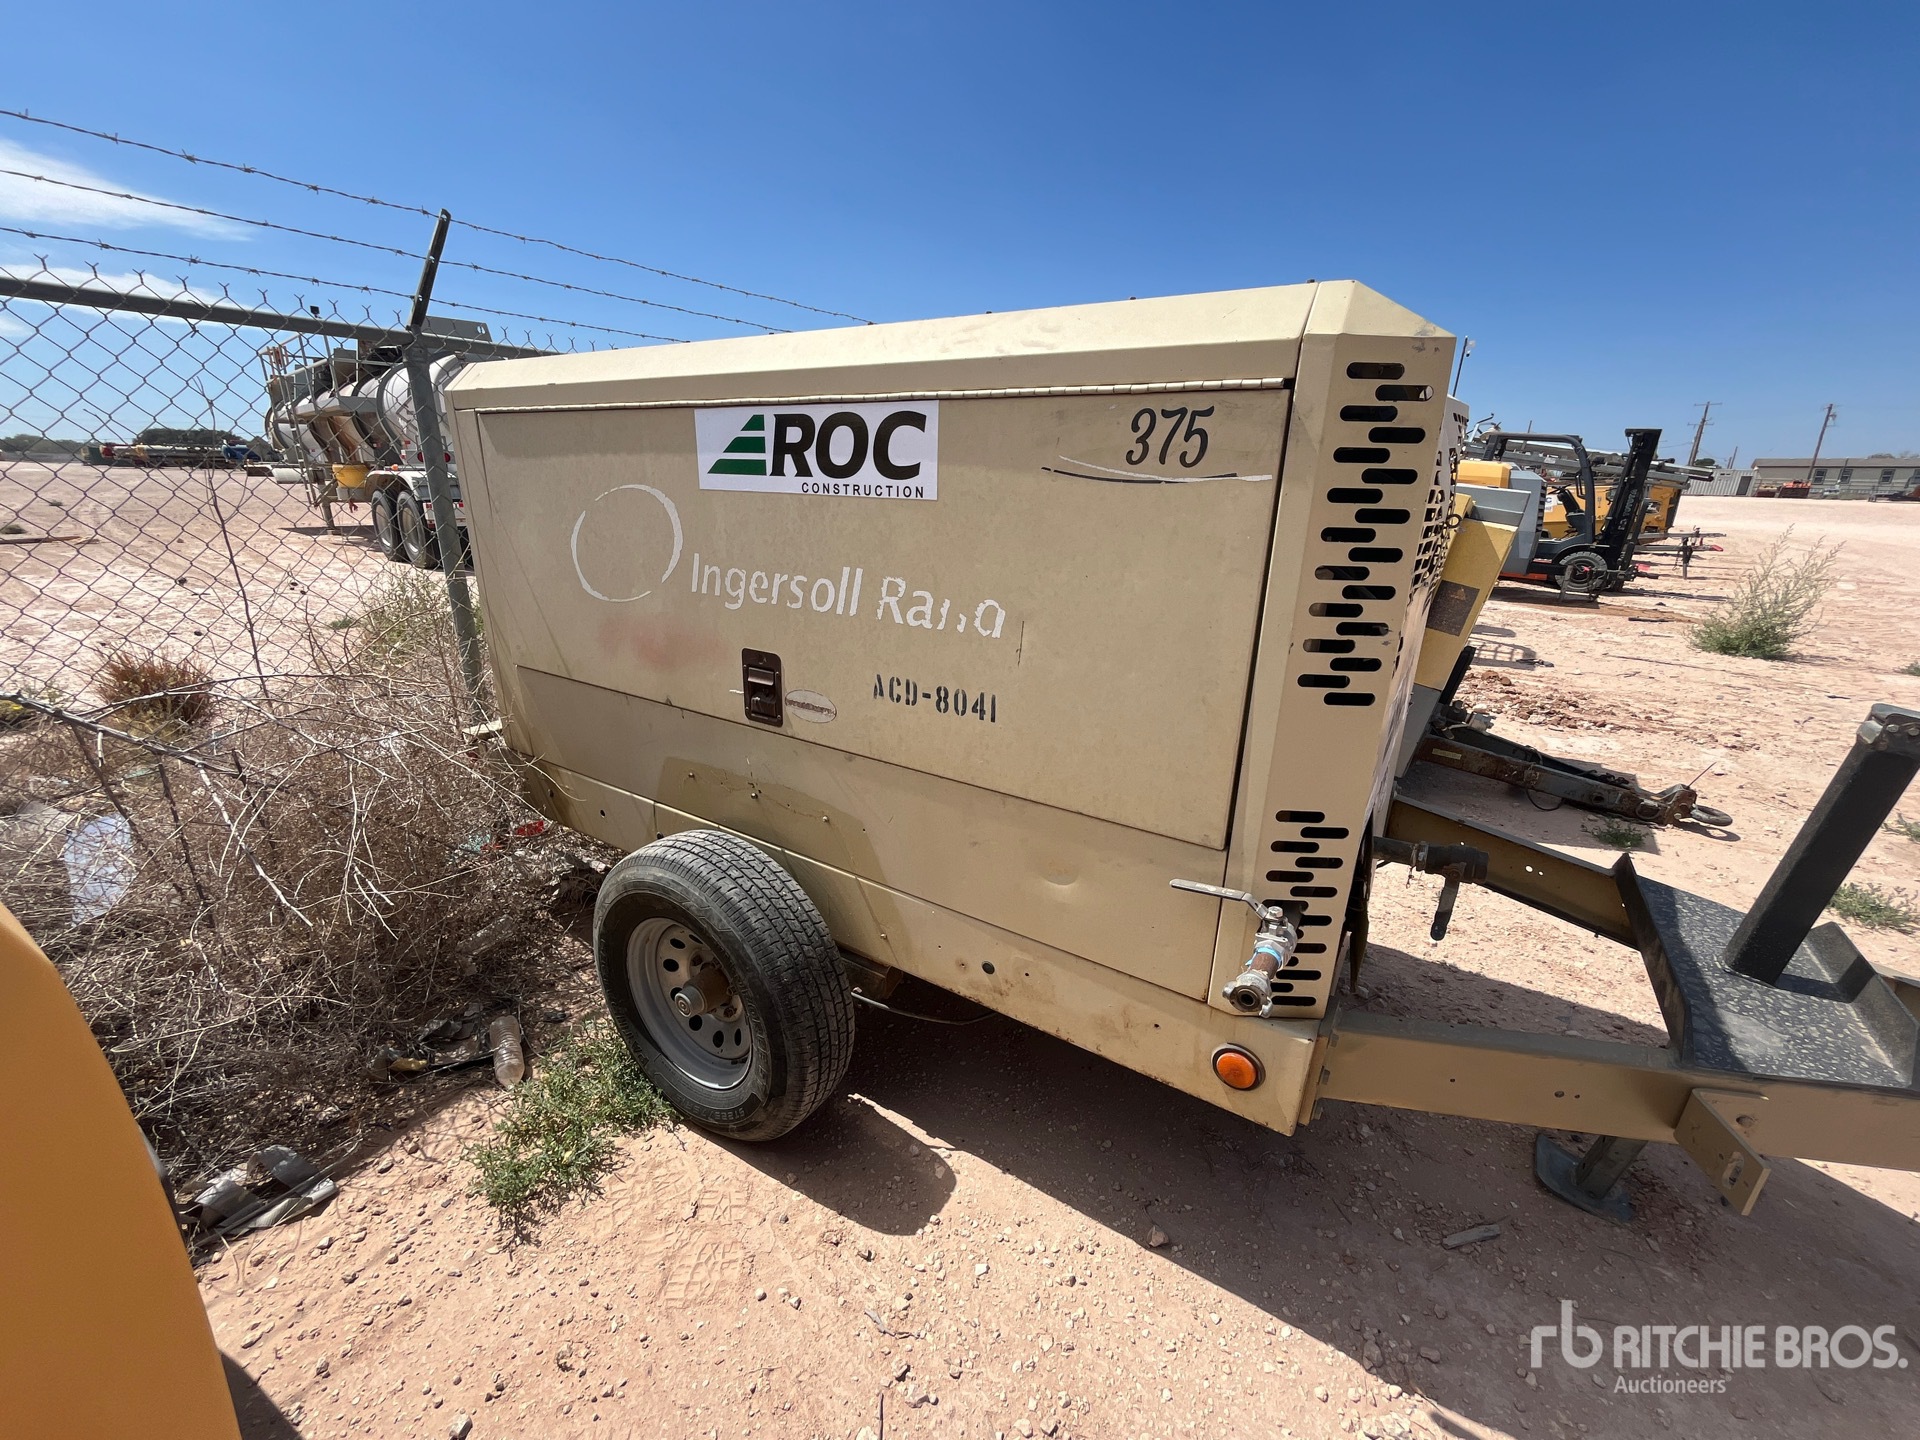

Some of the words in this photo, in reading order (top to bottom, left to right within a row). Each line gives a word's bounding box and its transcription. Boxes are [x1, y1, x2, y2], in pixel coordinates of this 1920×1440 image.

[769, 410, 927, 480] ROC
[1125, 405, 1215, 468] 375
[801, 482, 924, 499] CONSTRUCTION
[691, 552, 863, 617] Ingersoll
[873, 673, 997, 723] ACD-8041
